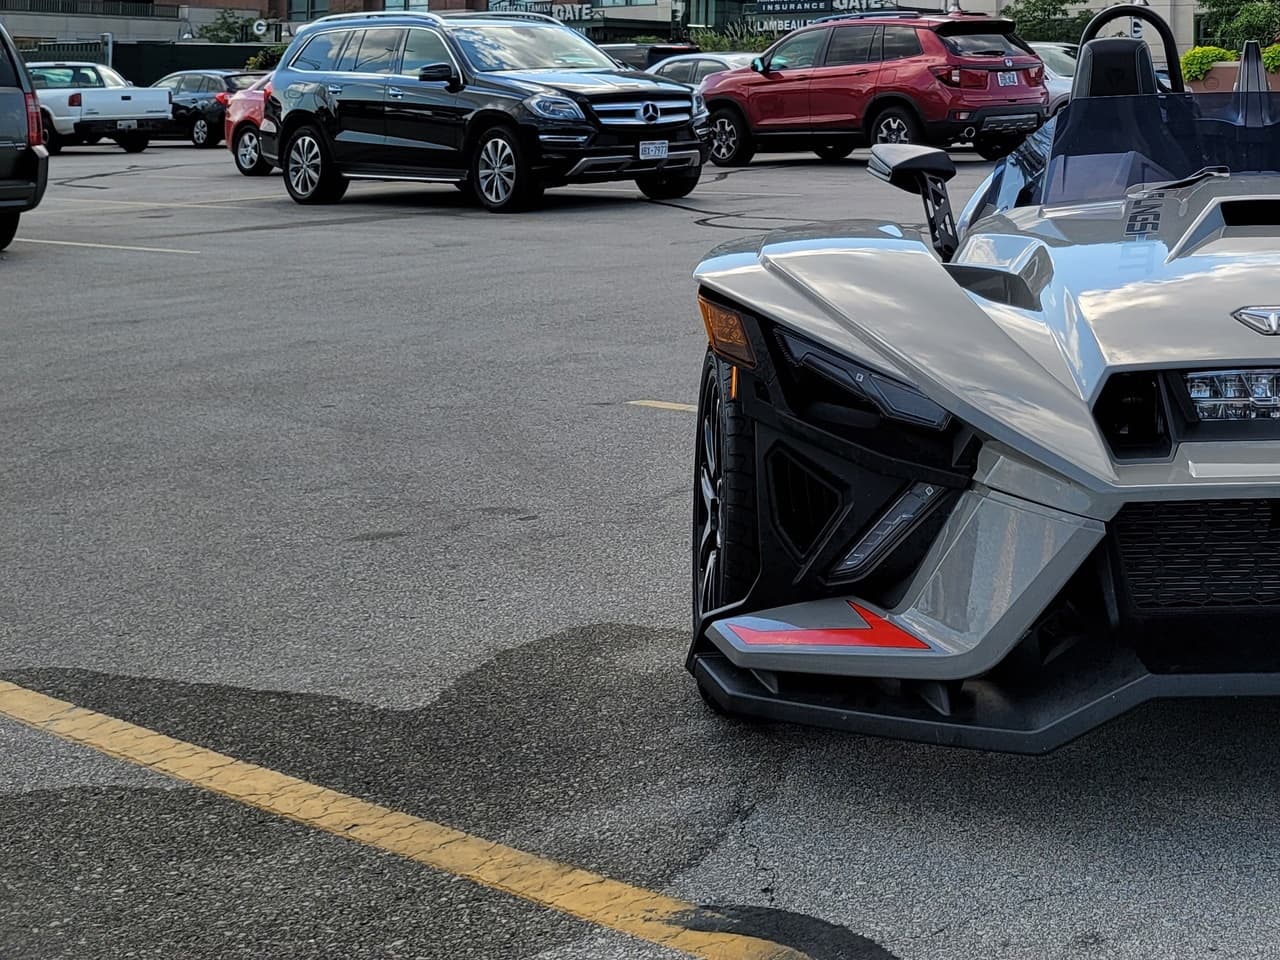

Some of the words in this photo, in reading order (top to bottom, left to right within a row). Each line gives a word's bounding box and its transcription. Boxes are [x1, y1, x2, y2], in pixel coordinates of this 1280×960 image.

[493, 2, 526, 13] AMERICAN
[526, 2, 552, 14] FAMILY
[553, 3, 592, 21] GATE
[762, 2, 825, 11] INSURANCE
